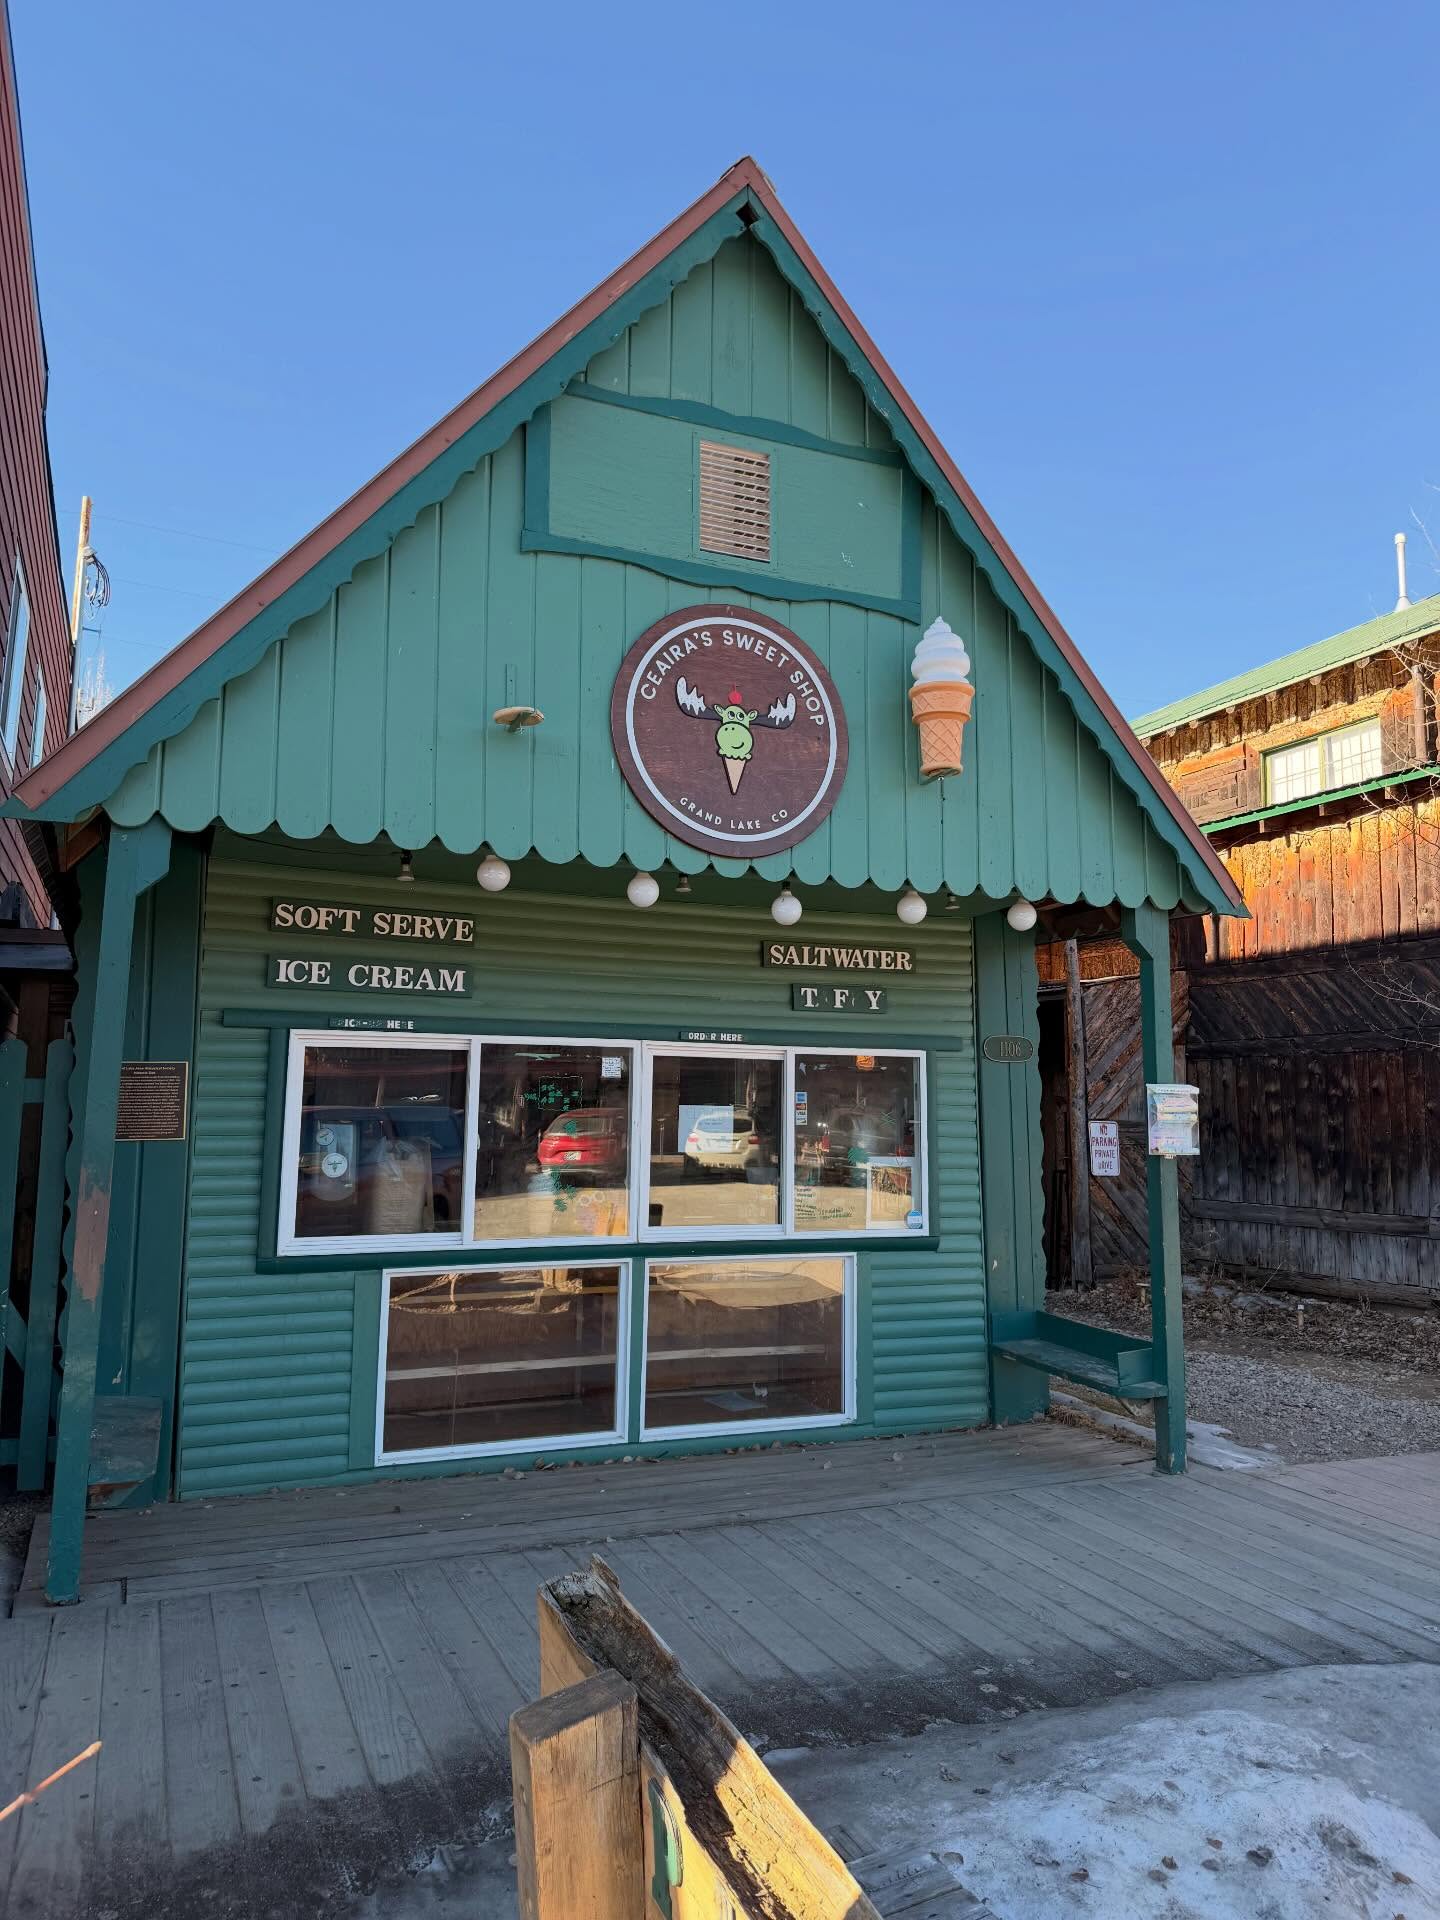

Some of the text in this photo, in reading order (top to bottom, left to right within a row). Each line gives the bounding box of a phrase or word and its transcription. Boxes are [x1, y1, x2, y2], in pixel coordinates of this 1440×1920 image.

[640, 629, 825, 726] CEAIRA'S SWEET SHOP
[679, 796, 789, 830] GRAND LAKE CO
[274, 903, 474, 942] SOFT SERVE
[769, 944, 913, 971] SALTWATER
[275, 959, 466, 992] ICE CREAM
[386, 1019, 414, 1030] HEE
[688, 1032, 743, 1042] ORDR HERE
[1000, 1041, 1022, 1057] 1106
[1099, 1125, 1108, 1135] NO
[1091, 1136, 1117, 1147] PARKING
[1094, 1149, 1116, 1159] PRIVATE
[1098, 1160, 1113, 1170] DRIVE
